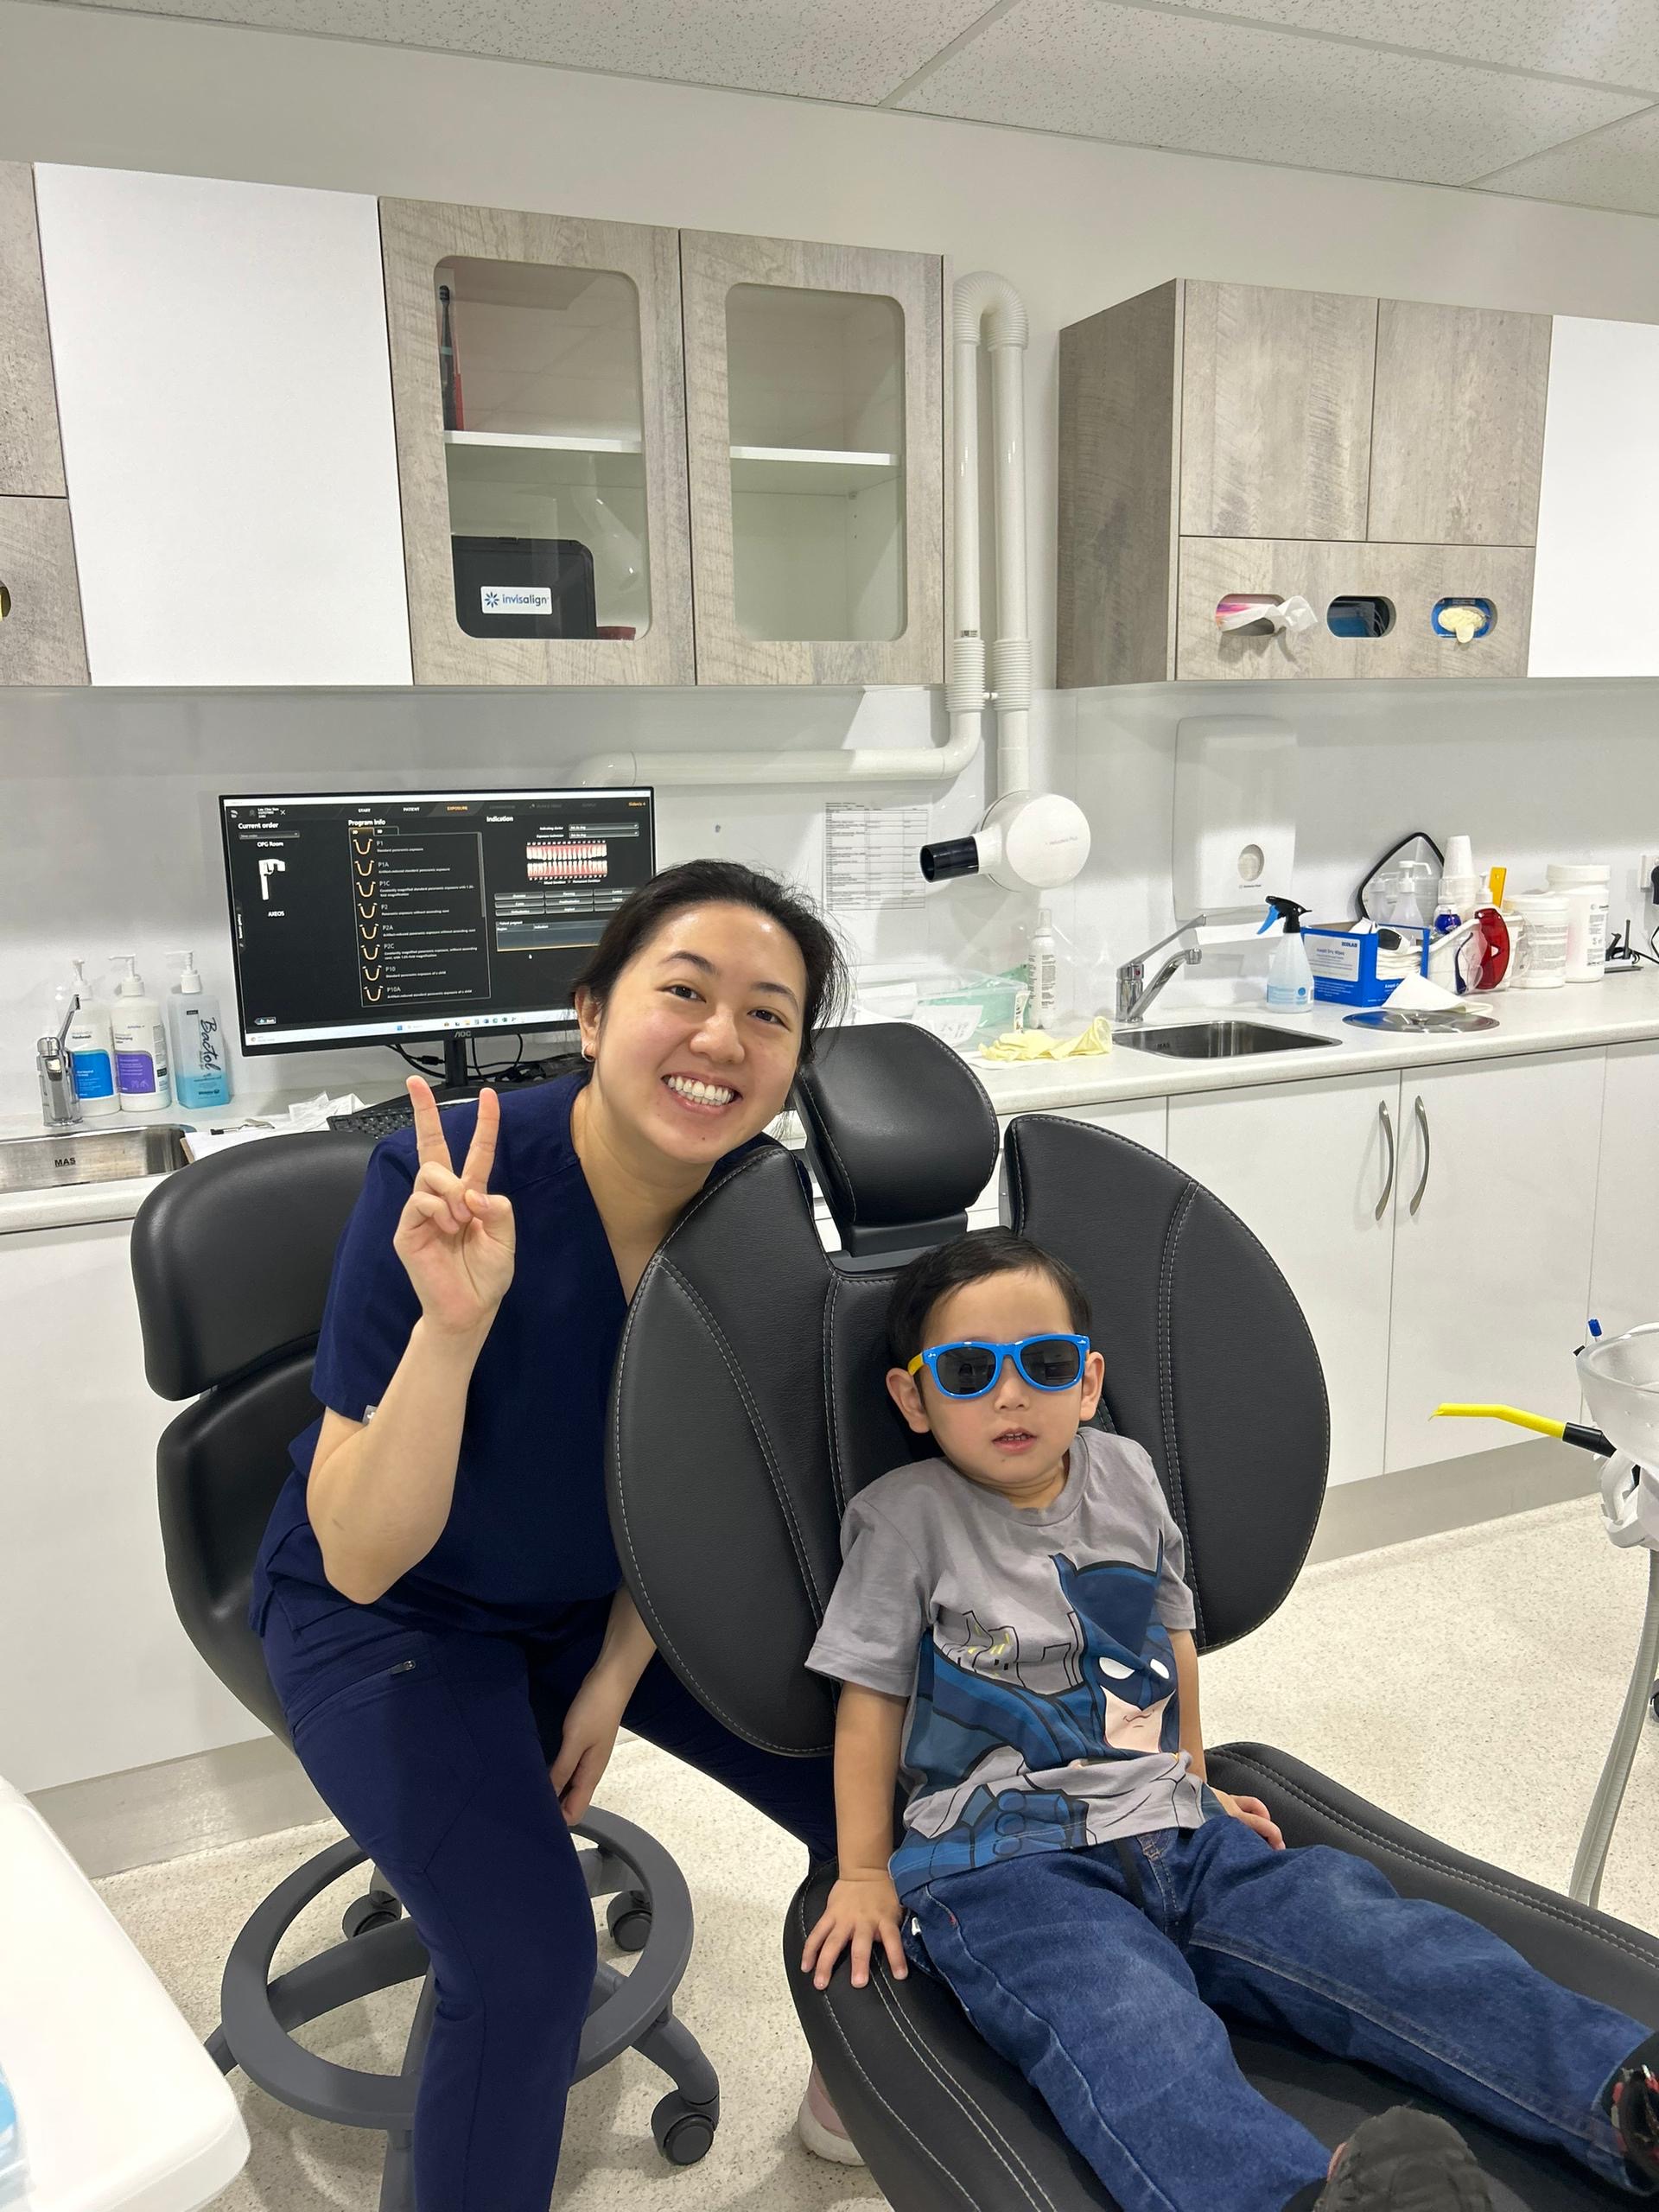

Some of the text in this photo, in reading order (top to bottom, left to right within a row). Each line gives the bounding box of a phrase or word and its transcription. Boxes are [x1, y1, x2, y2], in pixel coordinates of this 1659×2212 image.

[502, 594, 547, 607] invisalign
[200, 1017, 221, 1071] Bactol
[54, 1157, 76, 1167] MAS
